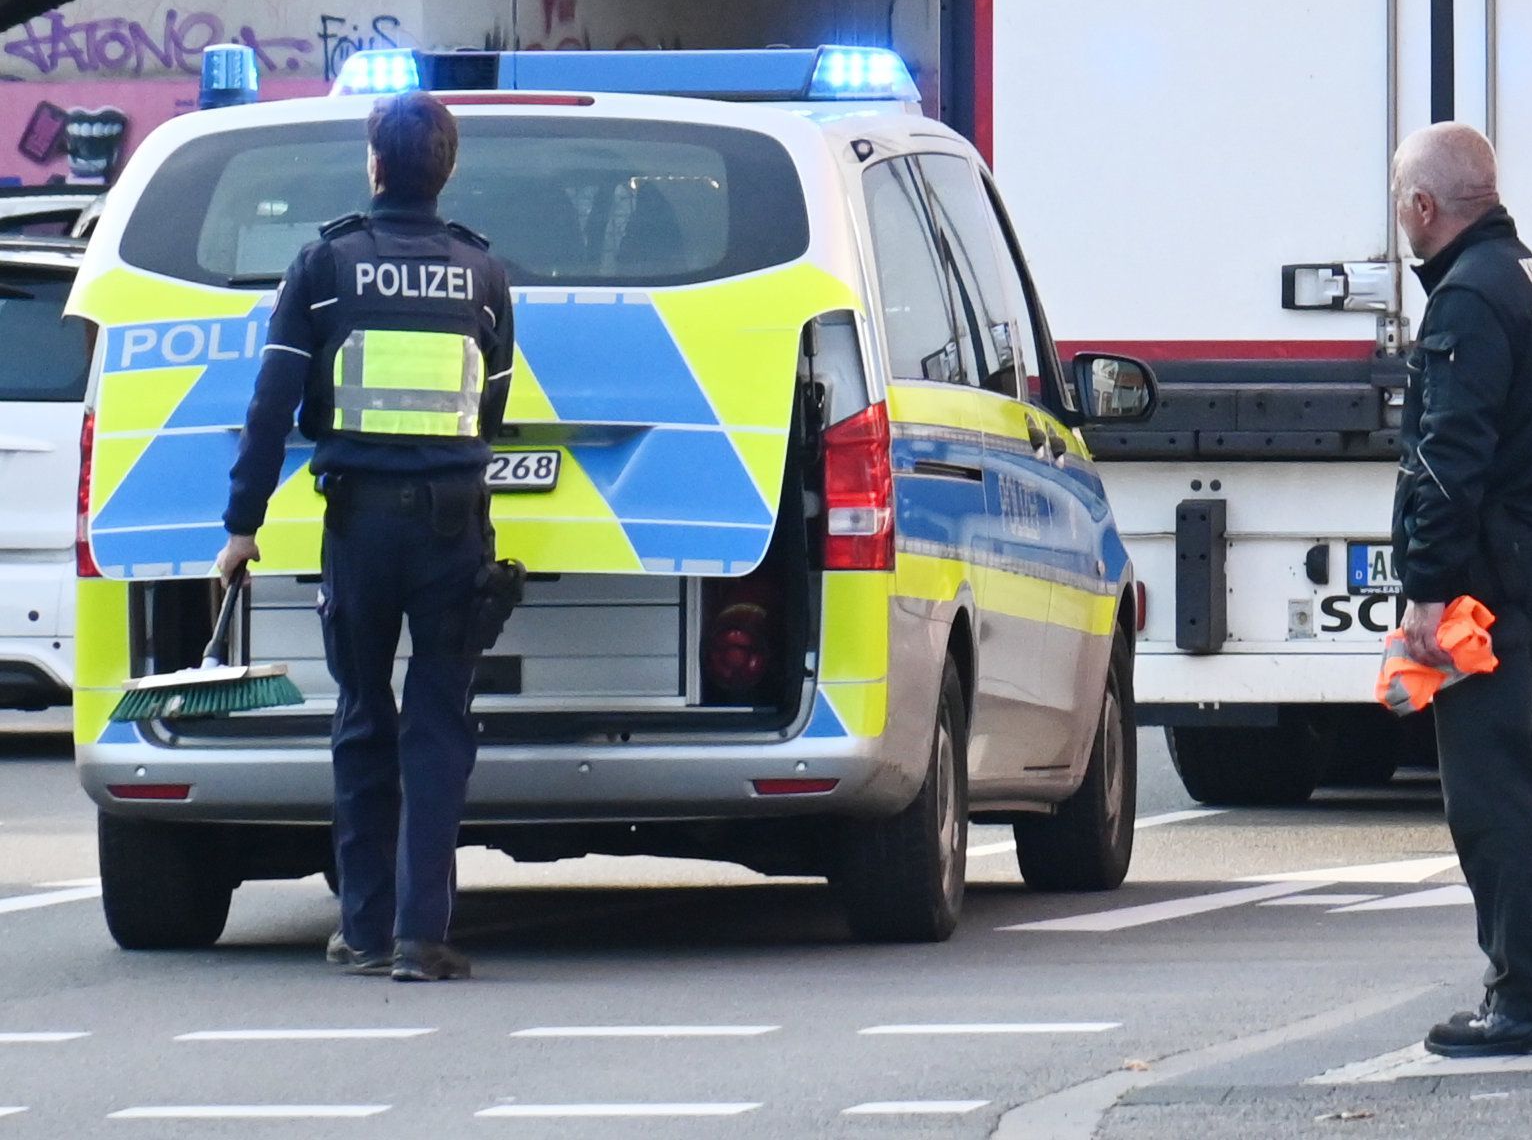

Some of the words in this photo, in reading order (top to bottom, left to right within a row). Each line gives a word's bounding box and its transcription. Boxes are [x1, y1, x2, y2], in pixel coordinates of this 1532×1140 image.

[356, 263, 474, 300] POLIZEI
[121, 320, 265, 368] POLI
[489, 456, 553, 481] 268
[1320, 595, 1401, 633] SC
